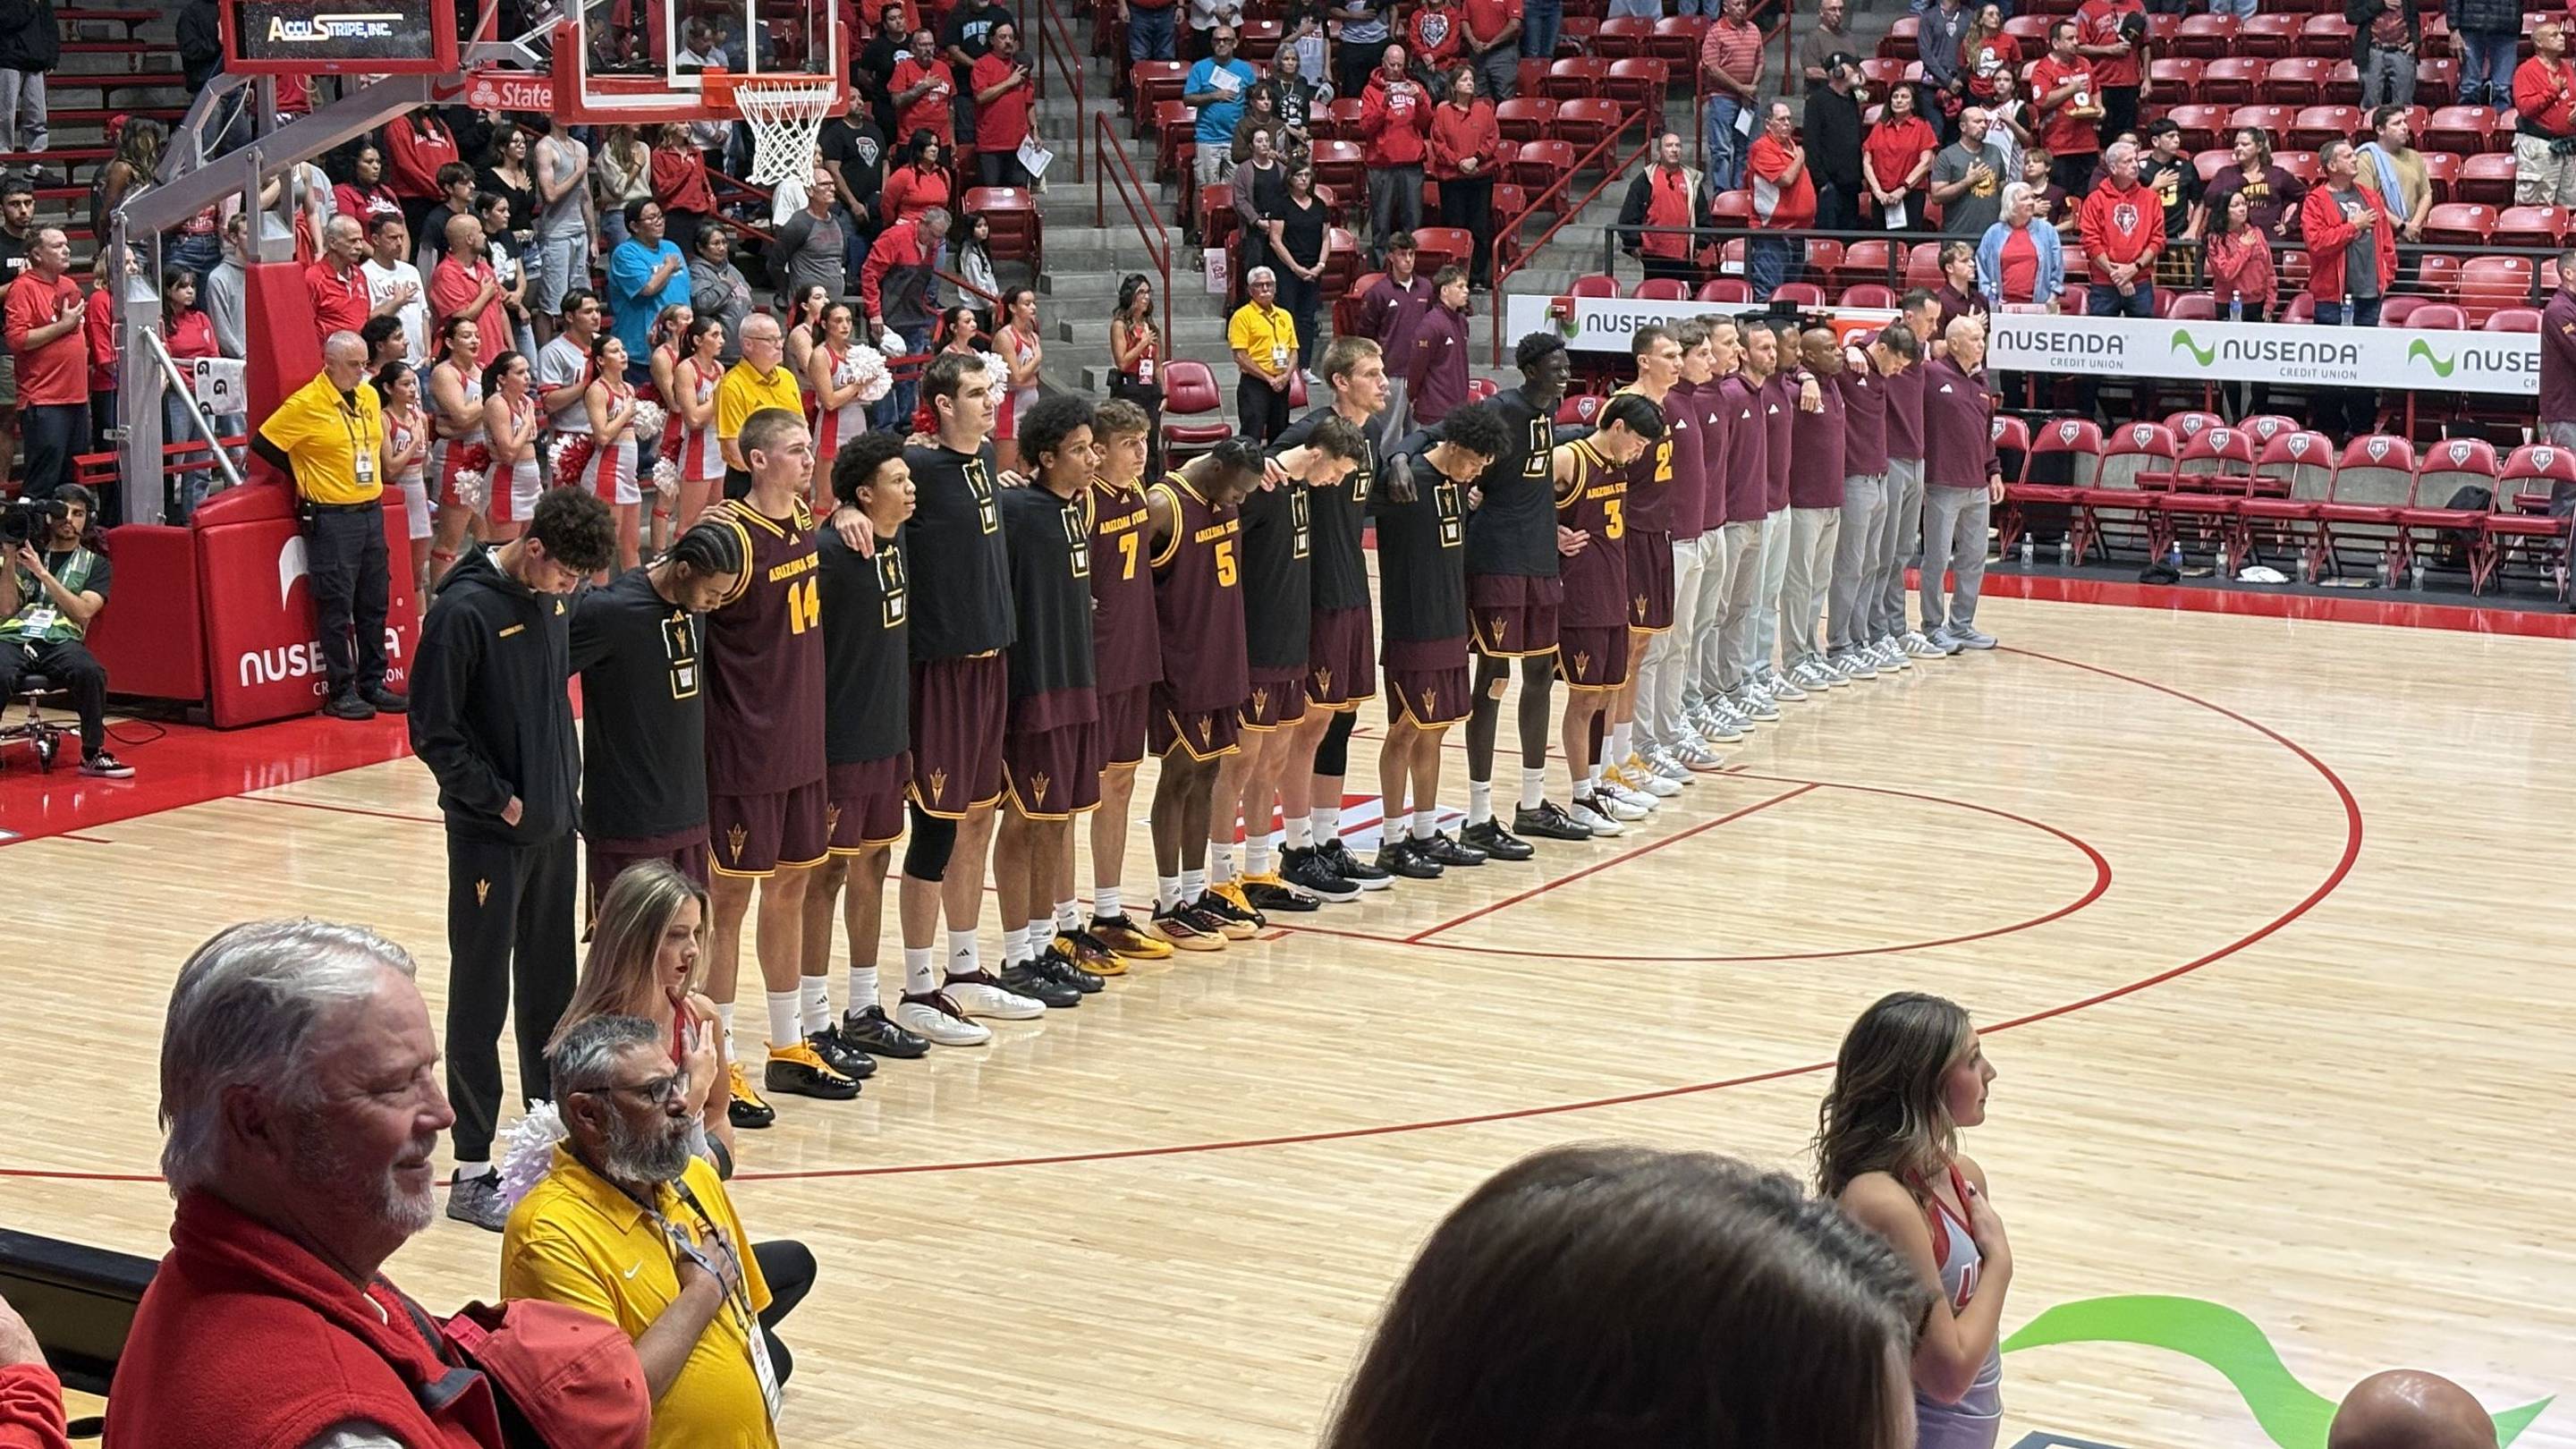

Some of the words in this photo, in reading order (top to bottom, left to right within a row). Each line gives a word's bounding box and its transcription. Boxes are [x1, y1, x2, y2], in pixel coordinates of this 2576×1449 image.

[501, 81, 553, 108] State
[1587, 314, 1672, 334] NUSE
[1997, 330, 2123, 354] NUSENDA
[2224, 339, 2358, 365] NUSENDA
[2050, 357, 2086, 369] CREDIT
[2089, 359, 2123, 369] UNION
[2280, 367, 2318, 378] CREDIT
[2321, 369, 2358, 380] UNION
[2463, 349, 2538, 371] NUSE
[1655, 439, 1673, 482] 2
[1604, 498, 1623, 539] 3
[1119, 530, 1139, 580] 7
[1215, 539, 1237, 588] 5
[788, 575, 820, 634] 14
[241, 627, 402, 687] NUSEA
